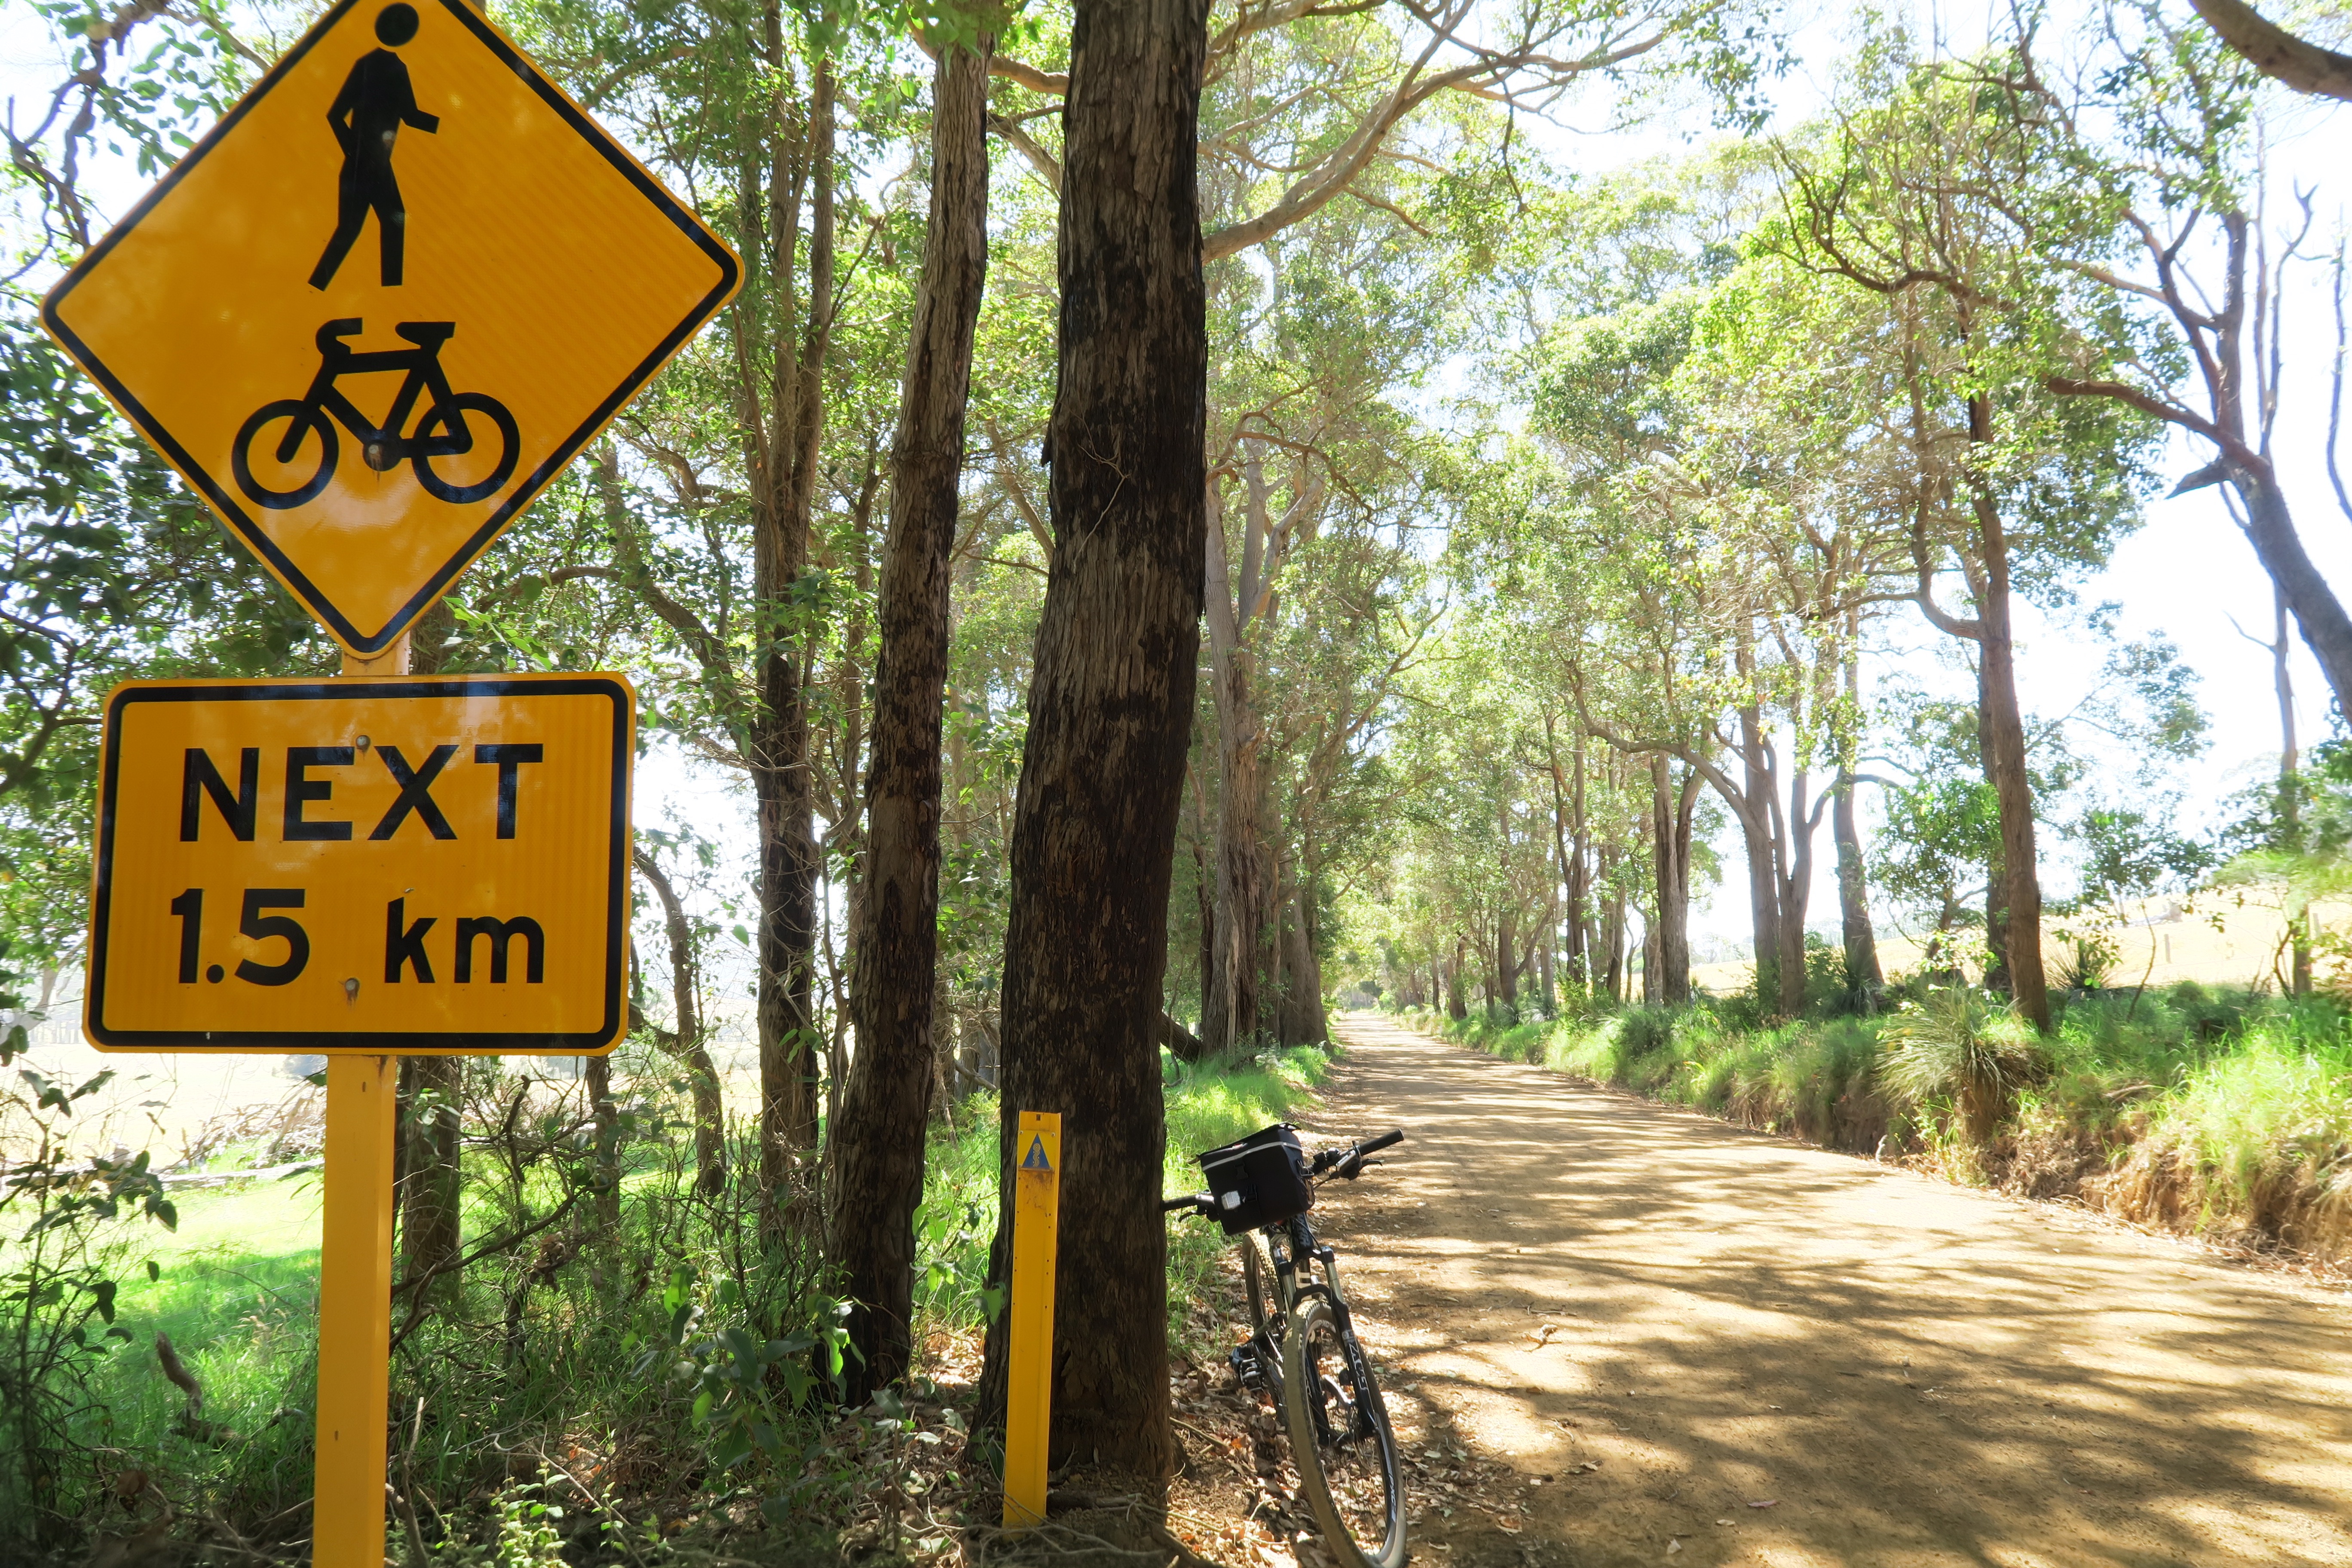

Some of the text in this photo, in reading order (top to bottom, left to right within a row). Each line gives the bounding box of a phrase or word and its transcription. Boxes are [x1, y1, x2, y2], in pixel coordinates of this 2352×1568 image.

[180, 743, 543, 842] NEXT
[171, 888, 545, 986] 1.5 km
